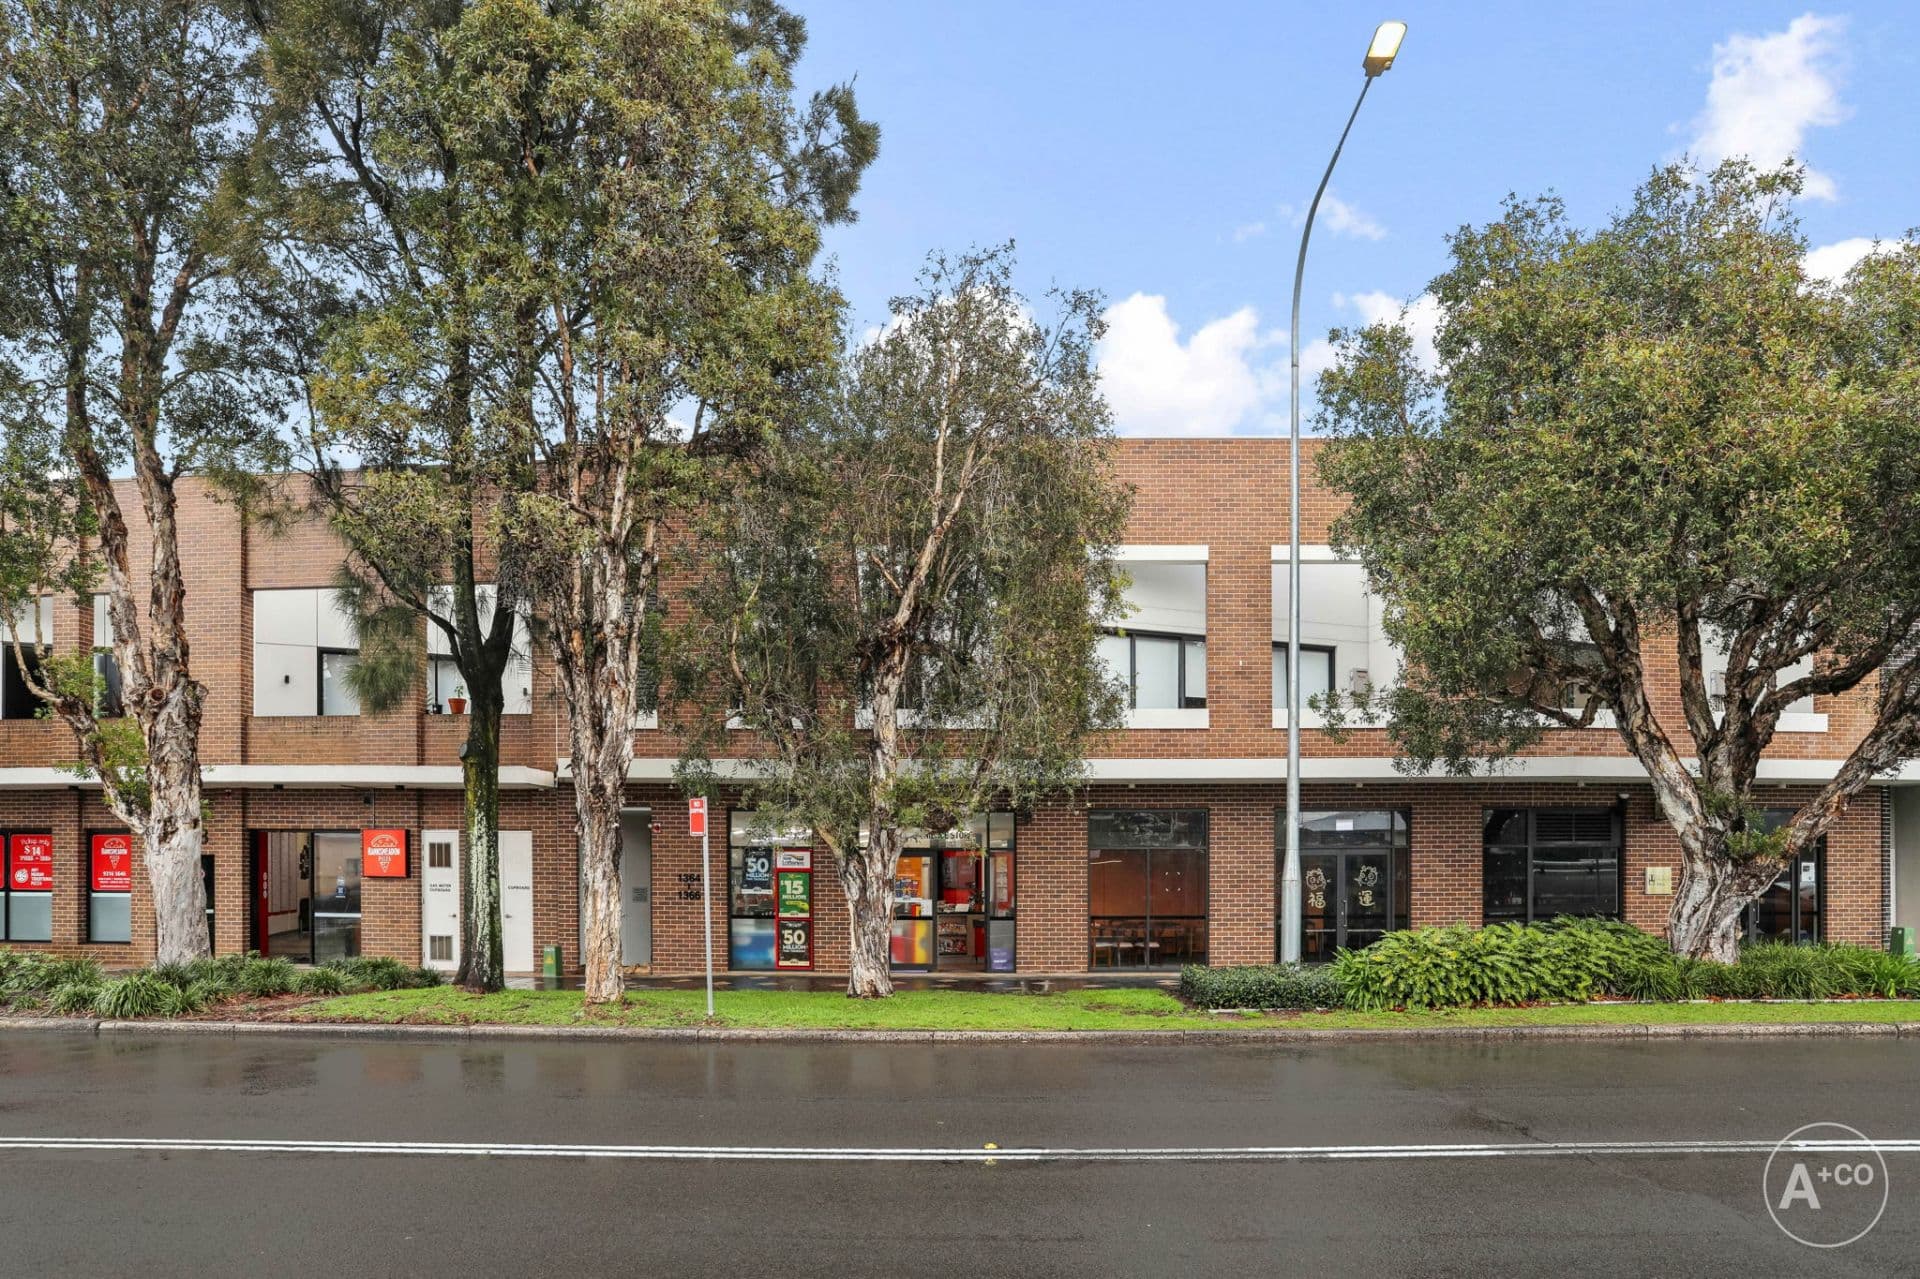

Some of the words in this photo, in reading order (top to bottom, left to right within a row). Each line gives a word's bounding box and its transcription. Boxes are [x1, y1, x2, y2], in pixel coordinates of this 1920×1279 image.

[678, 873, 701, 882] 1364
[677, 891, 701, 900] 1366
[1308, 891, 1326, 908] 福
